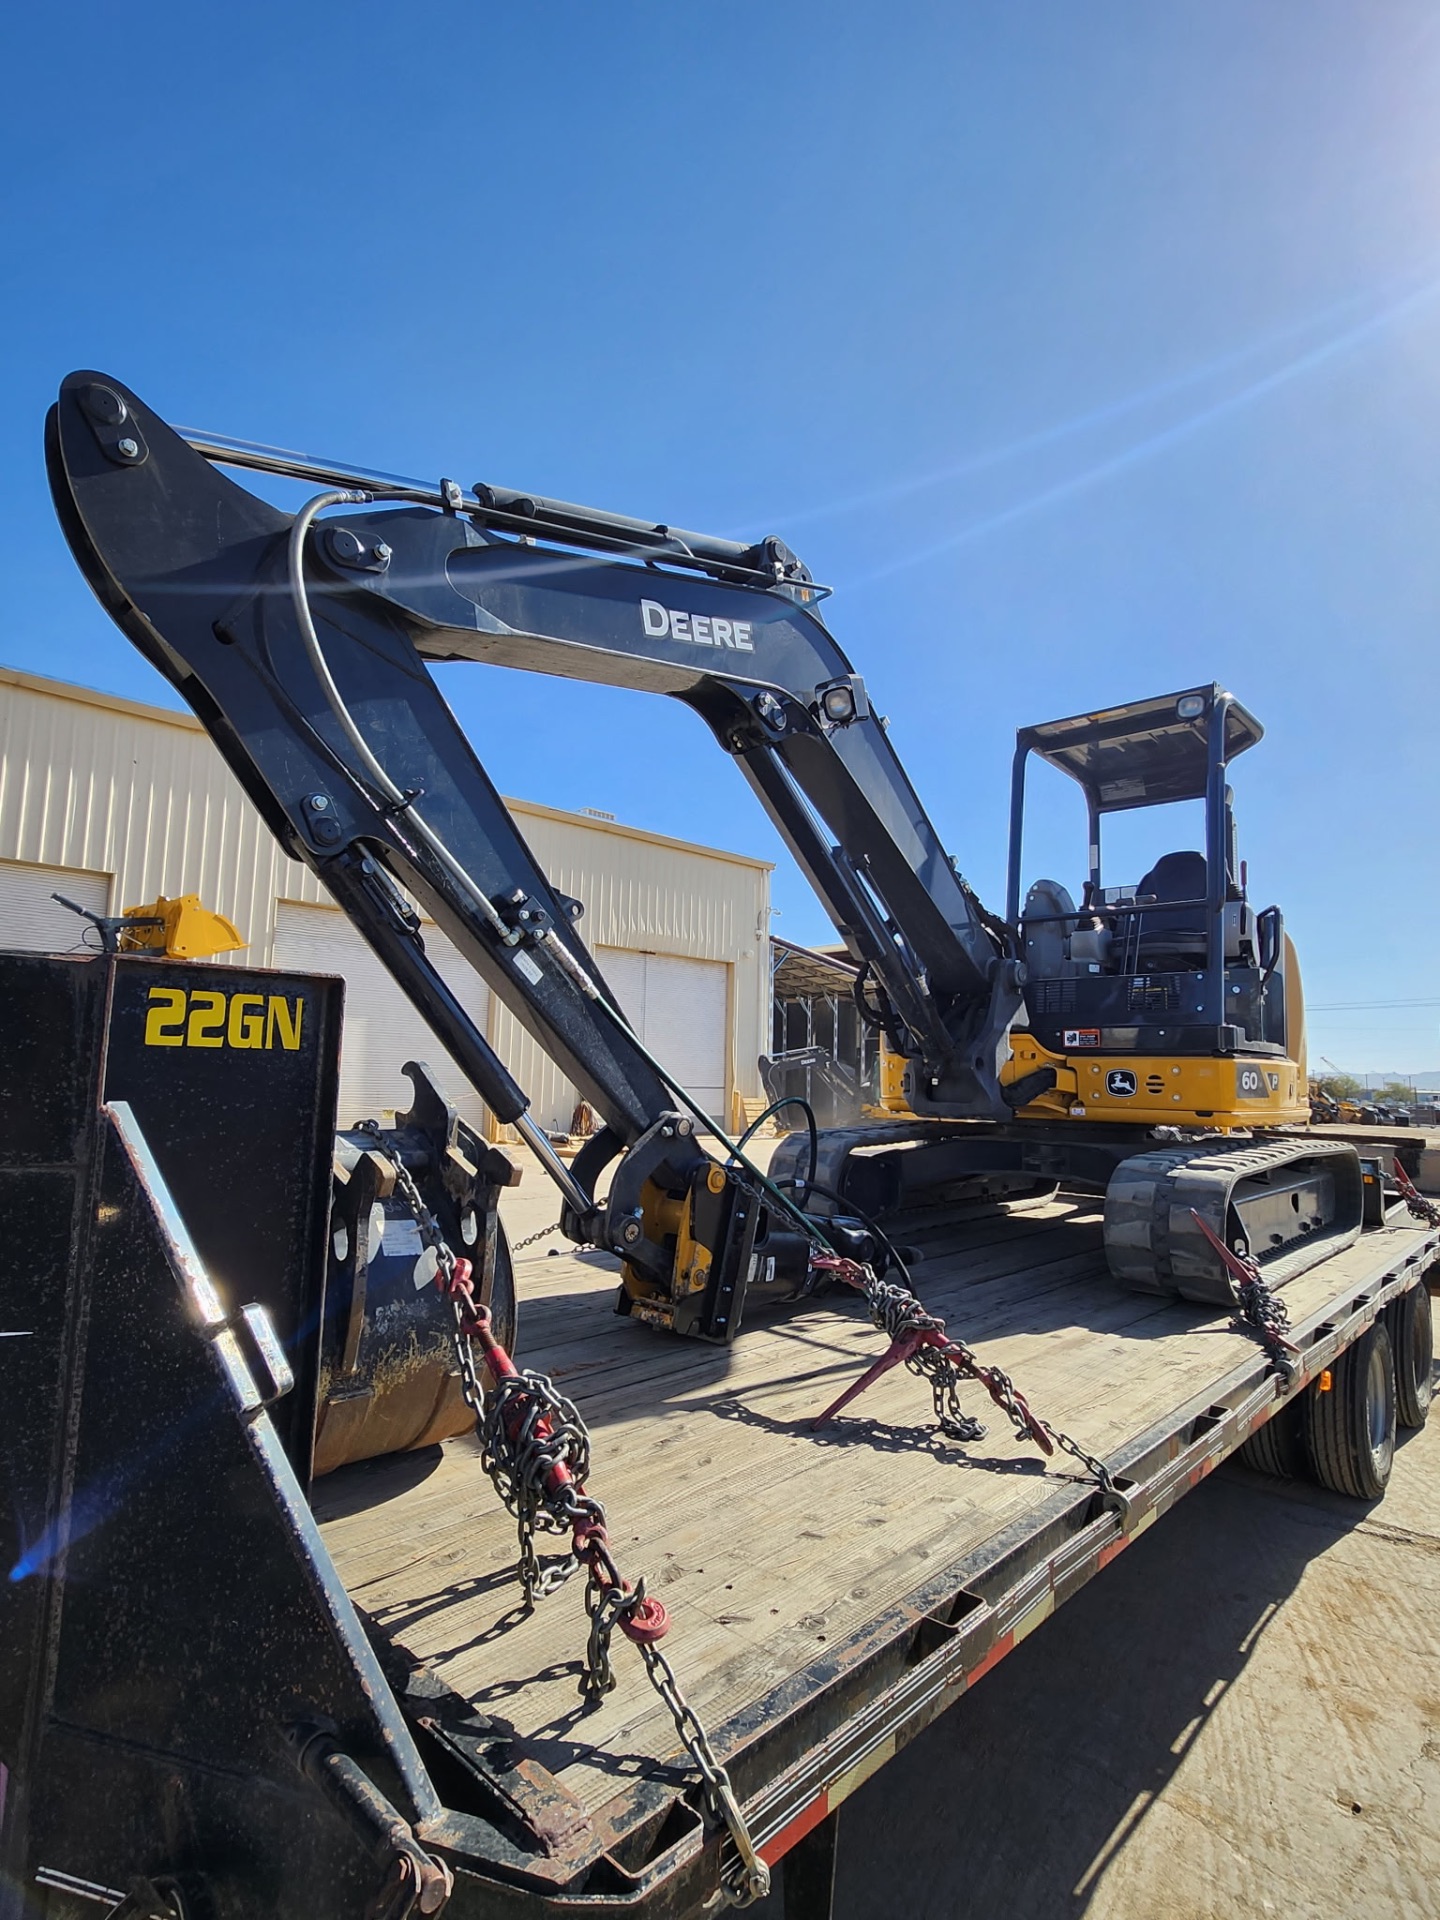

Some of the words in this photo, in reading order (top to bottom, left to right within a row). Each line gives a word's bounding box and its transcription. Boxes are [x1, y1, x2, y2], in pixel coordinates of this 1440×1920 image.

[641, 598, 753, 650] DEERE
[145, 987, 304, 1051] 22GN
[1241, 1071, 1258, 1090] 60
[1272, 1074, 1278, 1089] P
